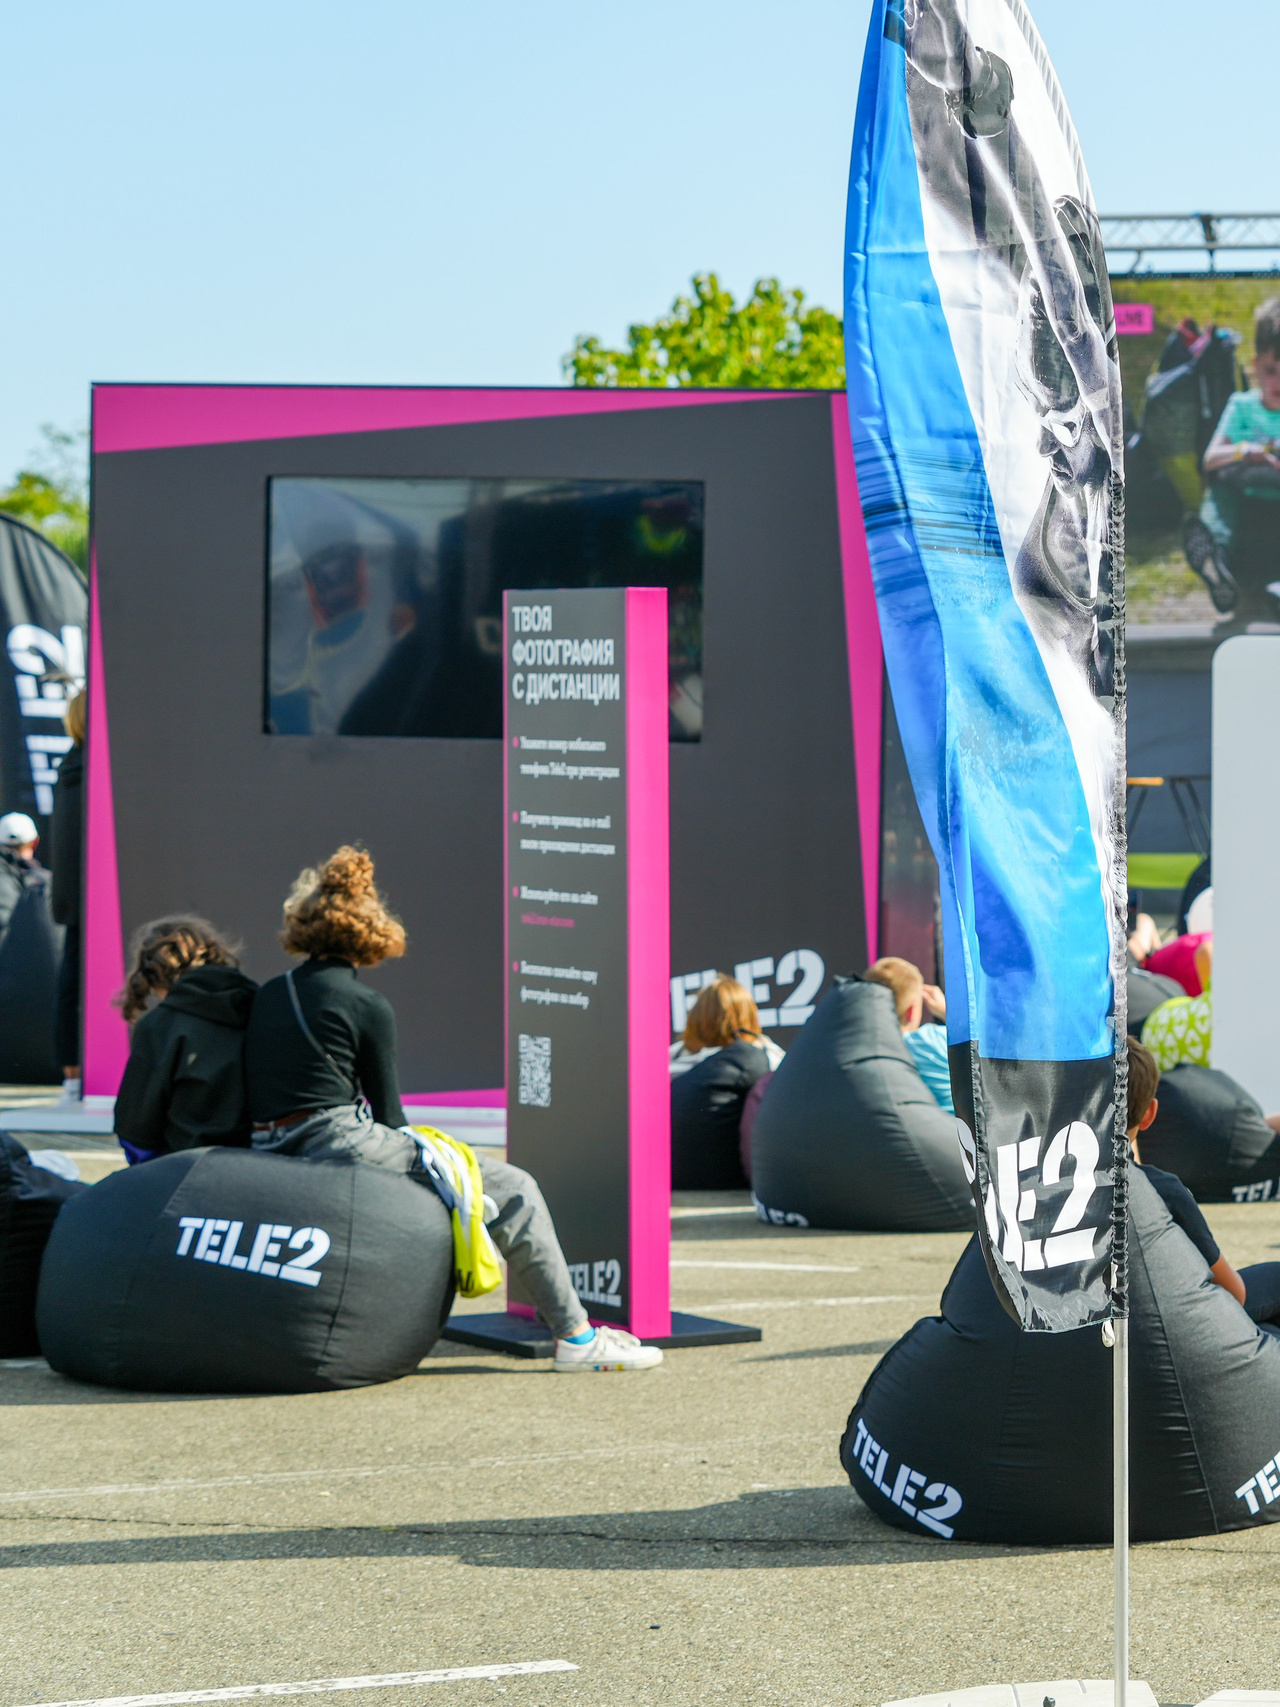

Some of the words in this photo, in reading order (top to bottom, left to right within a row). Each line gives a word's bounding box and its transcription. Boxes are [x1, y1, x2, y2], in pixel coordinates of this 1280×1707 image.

[511, 605, 552, 632] ТВОЯ
[511, 638, 615, 666] ФОТОГРАФИЯ
[512, 672, 525, 700] С
[526, 673, 620, 706] ДИСТАНЦИИ
[671, 949, 825, 1033] EE2
[176, 1216, 332, 1288] TELE2
[852, 1417, 963, 1539] TELE2
